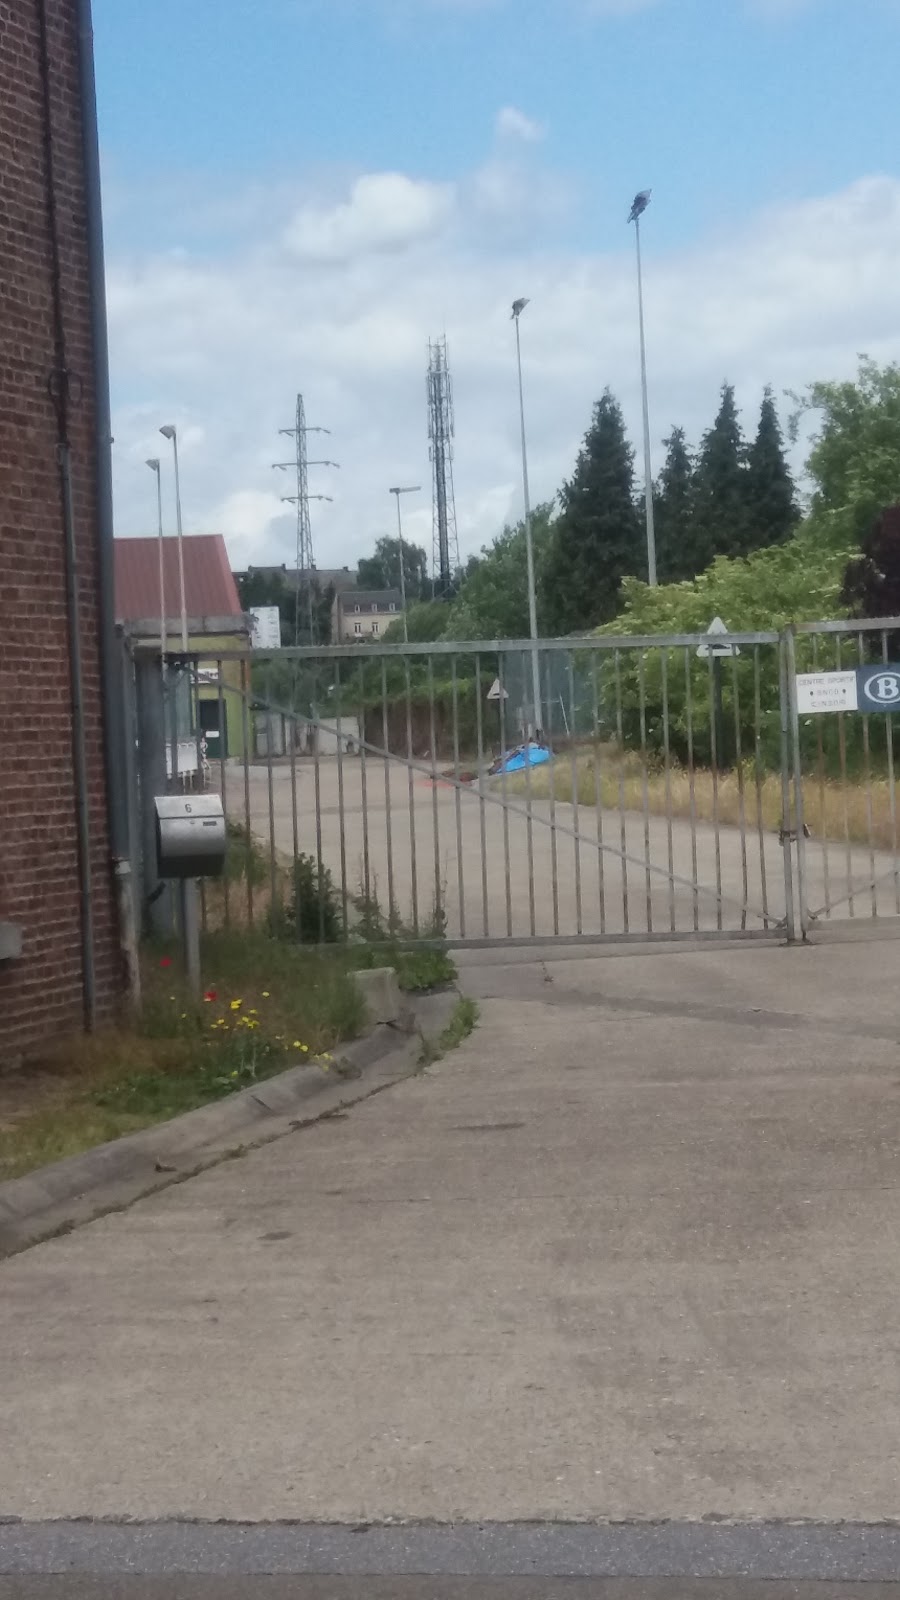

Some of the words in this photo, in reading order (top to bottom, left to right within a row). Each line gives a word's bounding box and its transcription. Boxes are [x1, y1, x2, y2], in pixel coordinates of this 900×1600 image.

[799, 678, 825, 686] CENTRE
[876, 676, 900, 699] B
[184, 803, 193, 814] 6
